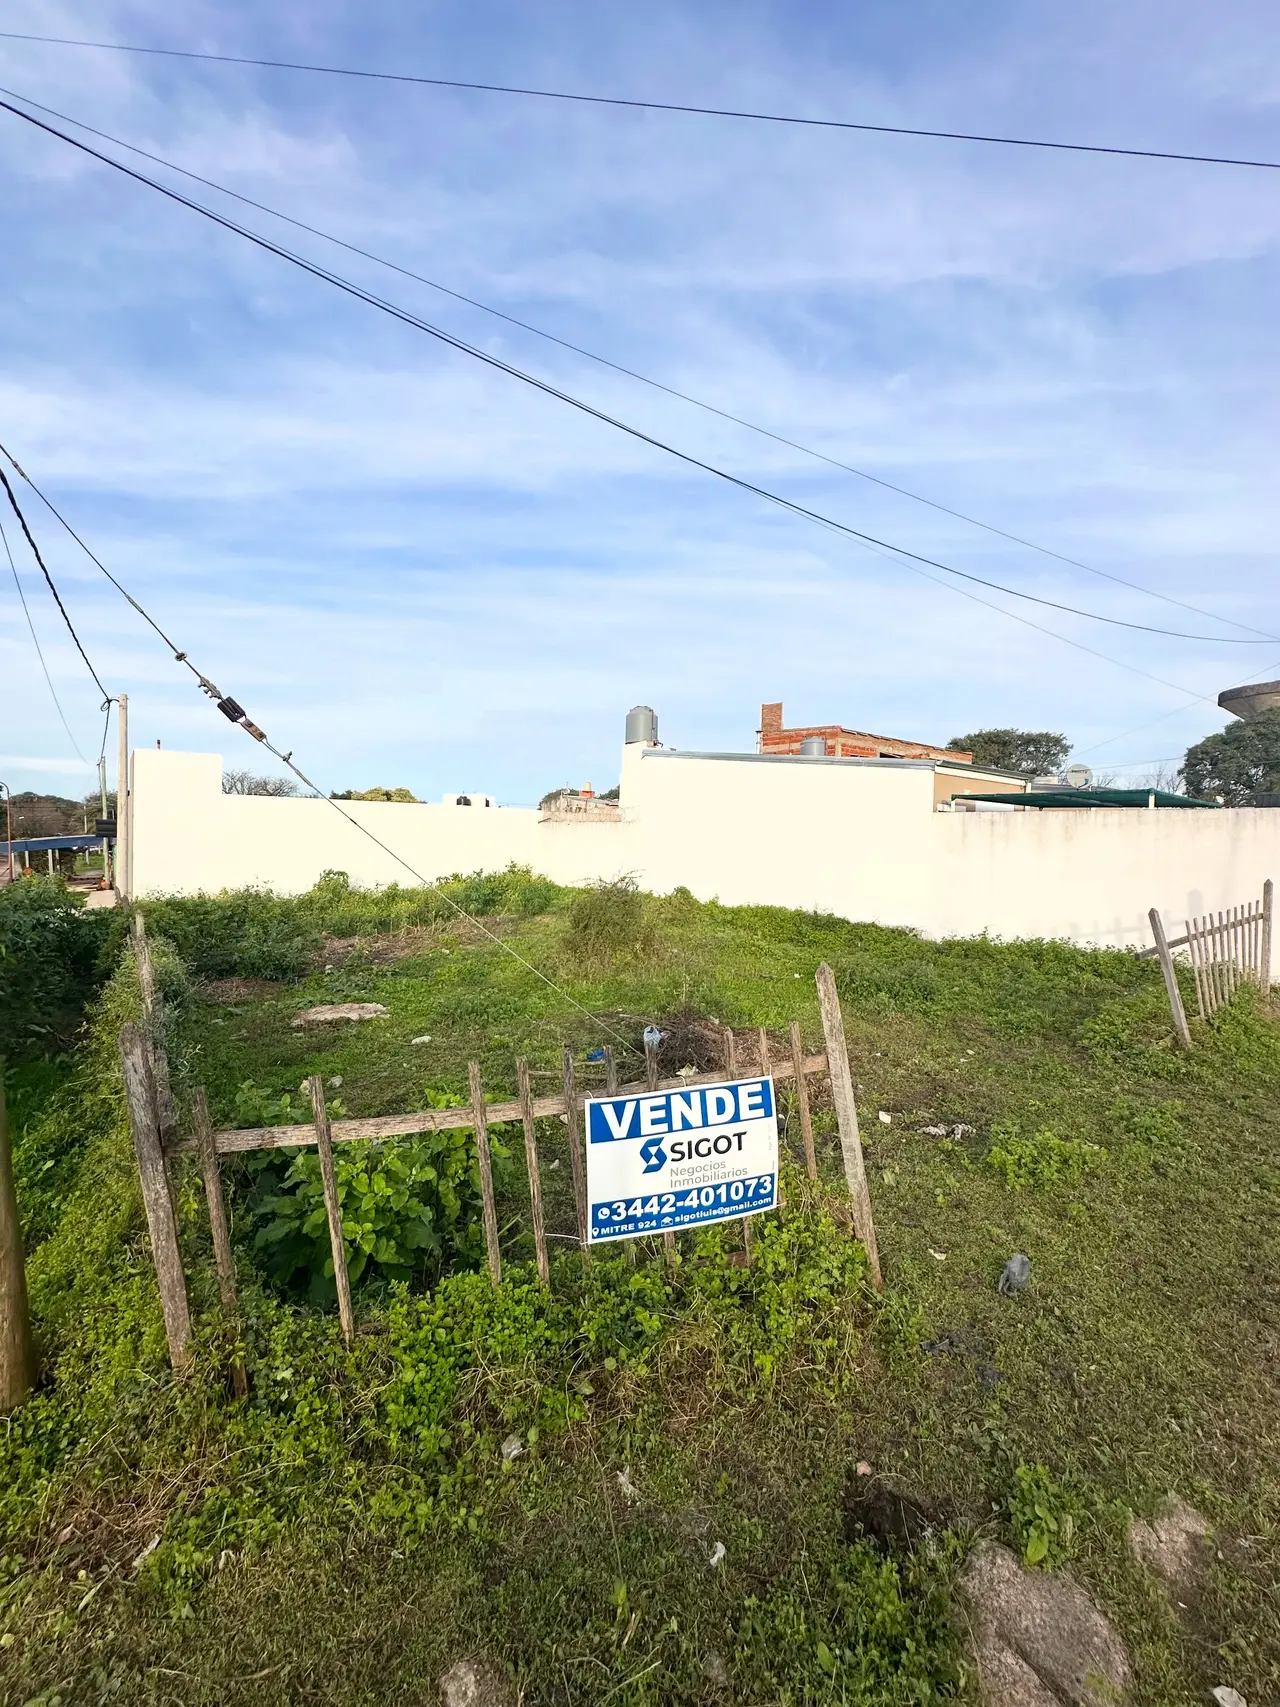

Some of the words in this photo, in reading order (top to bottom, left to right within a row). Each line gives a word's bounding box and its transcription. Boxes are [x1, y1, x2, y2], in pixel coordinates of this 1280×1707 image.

[601, 1082, 765, 1139] VENDE
[670, 1131, 747, 1162] SIGOT
[670, 1161, 726, 1177] Negocios
[670, 1167, 748, 1188] Inmobiliarios
[611, 1175, 772, 1221] 3442-401073
[674, 1197, 772, 1222] sigotluis@gmail.com
[601, 1223, 635, 1235] MITRE
[638, 1220, 657, 1229] 924
